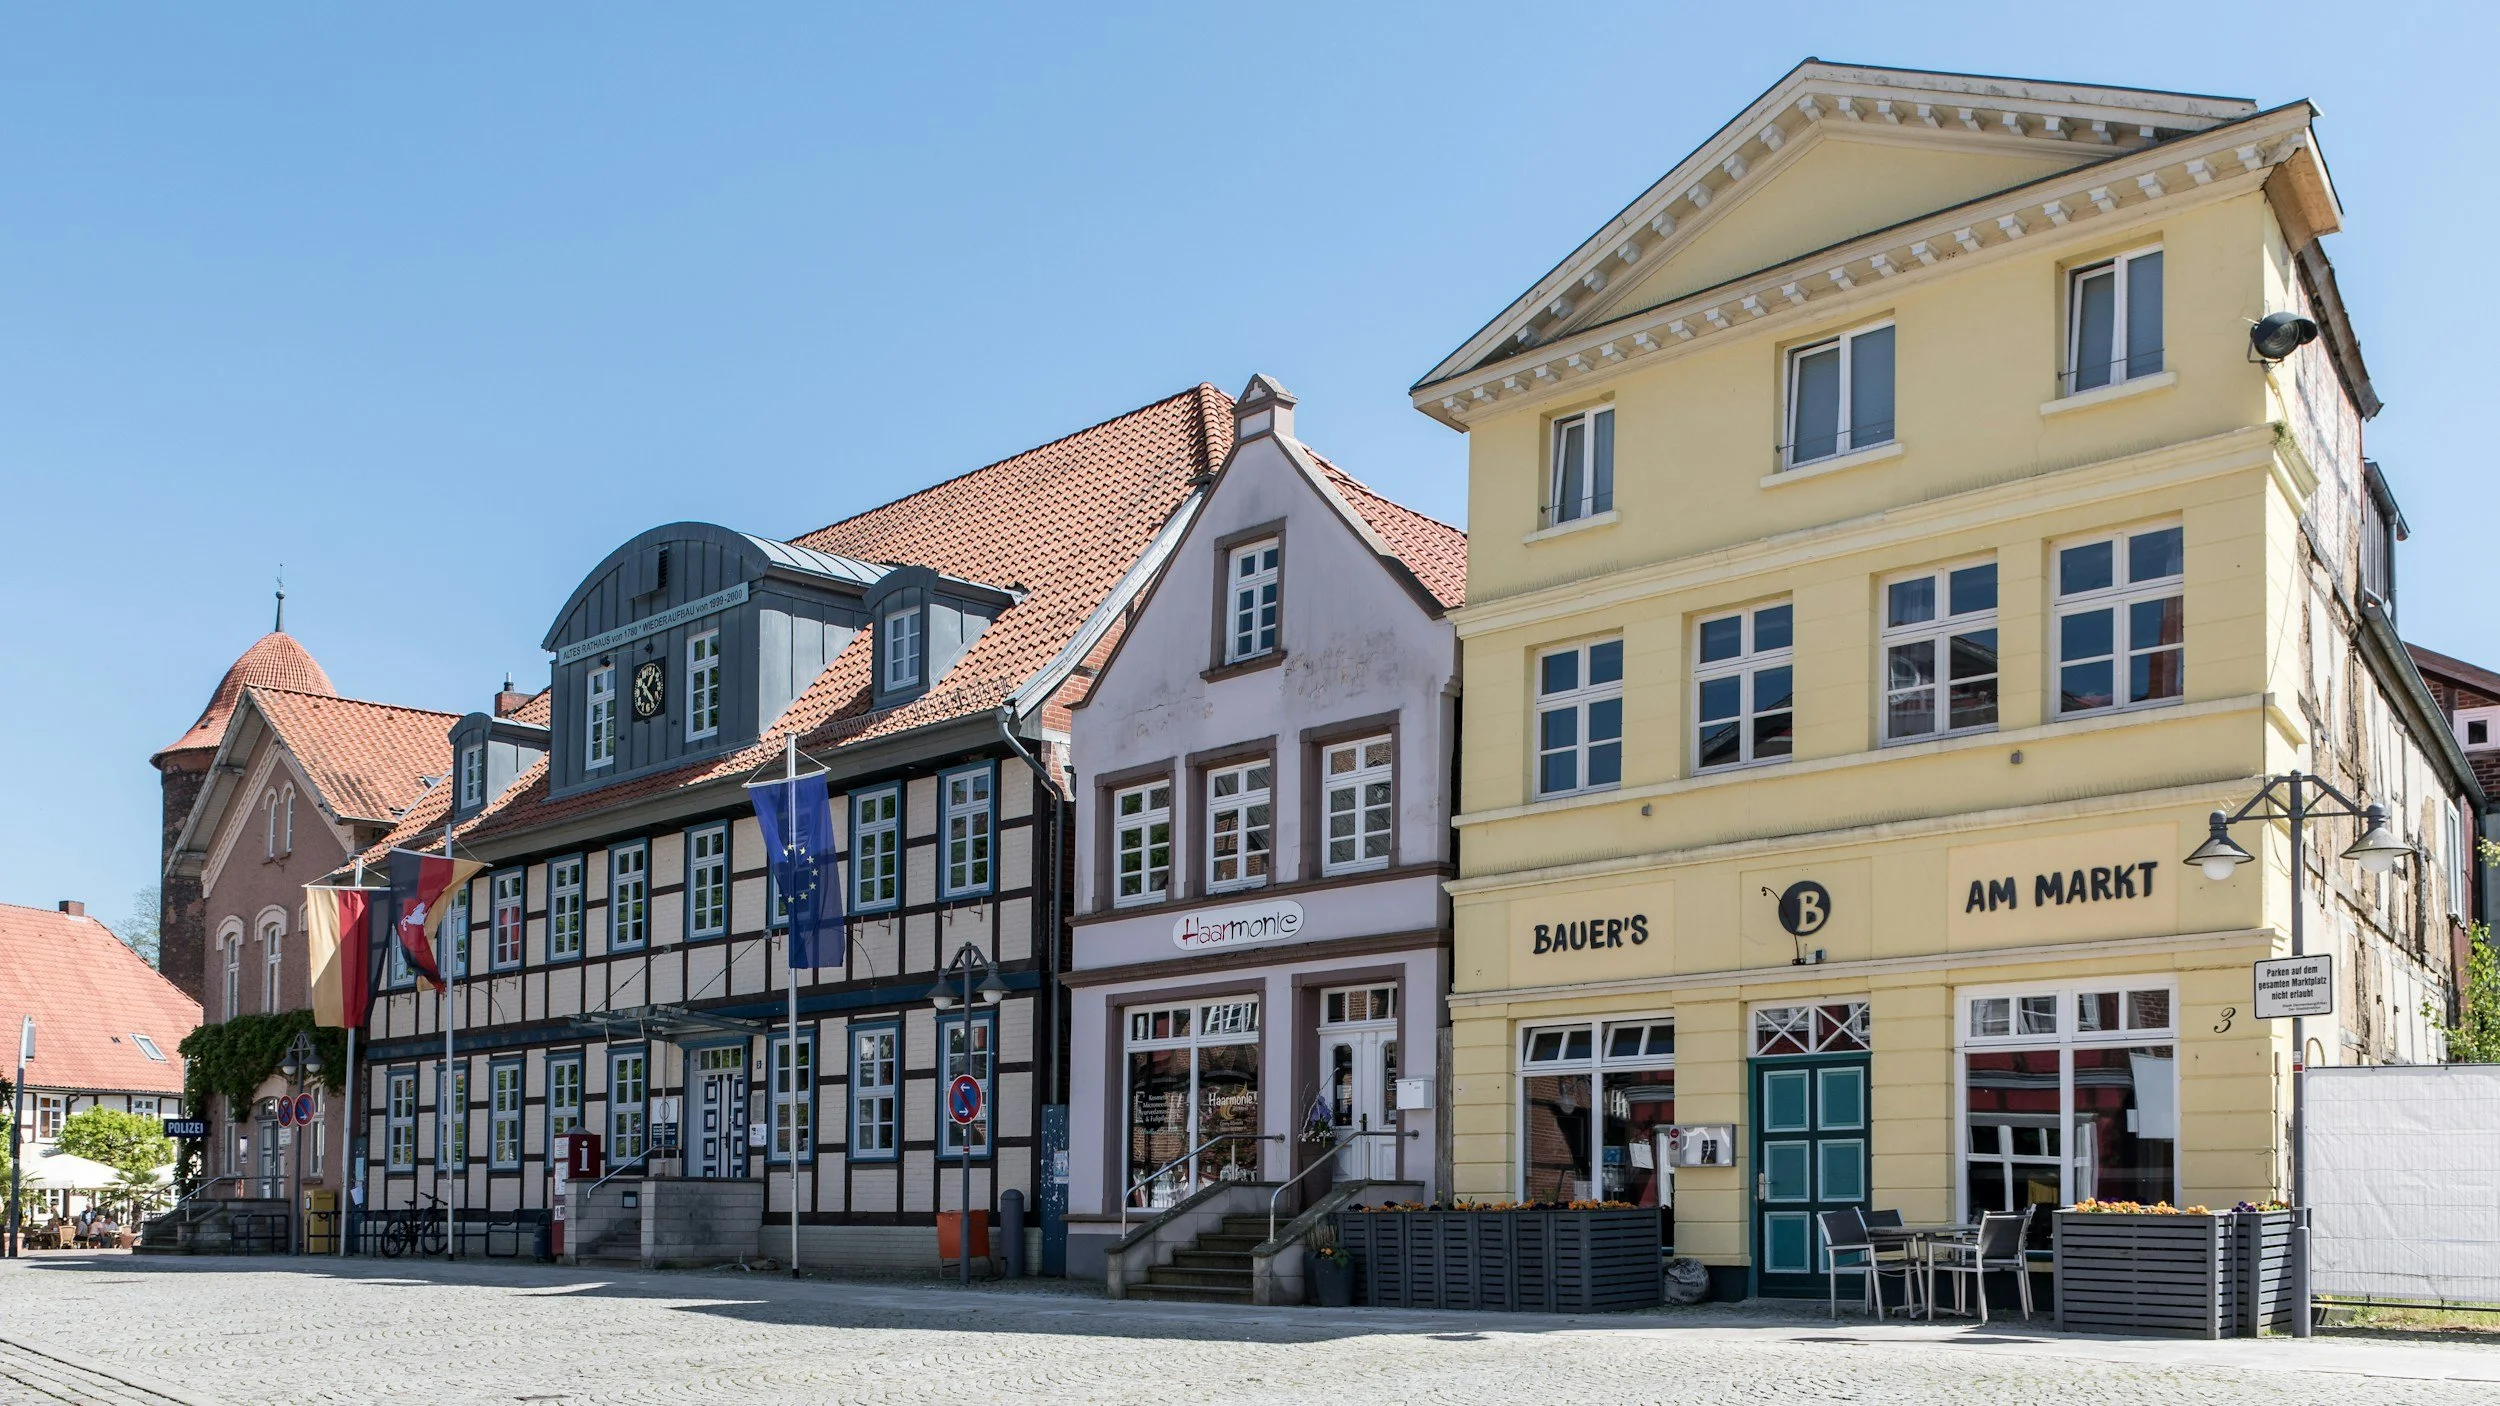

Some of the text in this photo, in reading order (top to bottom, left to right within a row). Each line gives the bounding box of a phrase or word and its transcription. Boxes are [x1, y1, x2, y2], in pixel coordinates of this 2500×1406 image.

[563, 646, 581, 660] ALTES
[581, 635, 611, 653] RATHAUS
[642, 605, 695, 632] WIEDERAUFBAU
[1965, 861, 2158, 914] AM MARKT
[1796, 890, 1825, 932] B
[1182, 911, 1298, 946] Haarmonie
[1533, 914, 1649, 955] BAUER'S
[2258, 976, 2327, 991] gesamten Marktplatz
[2266, 965, 2318, 978] Parken auf dem
[2271, 988, 2314, 1001] nicht erlaubt
[2213, 1007, 2236, 1034] 3
[168, 1122, 204, 1134] POLIZEI
